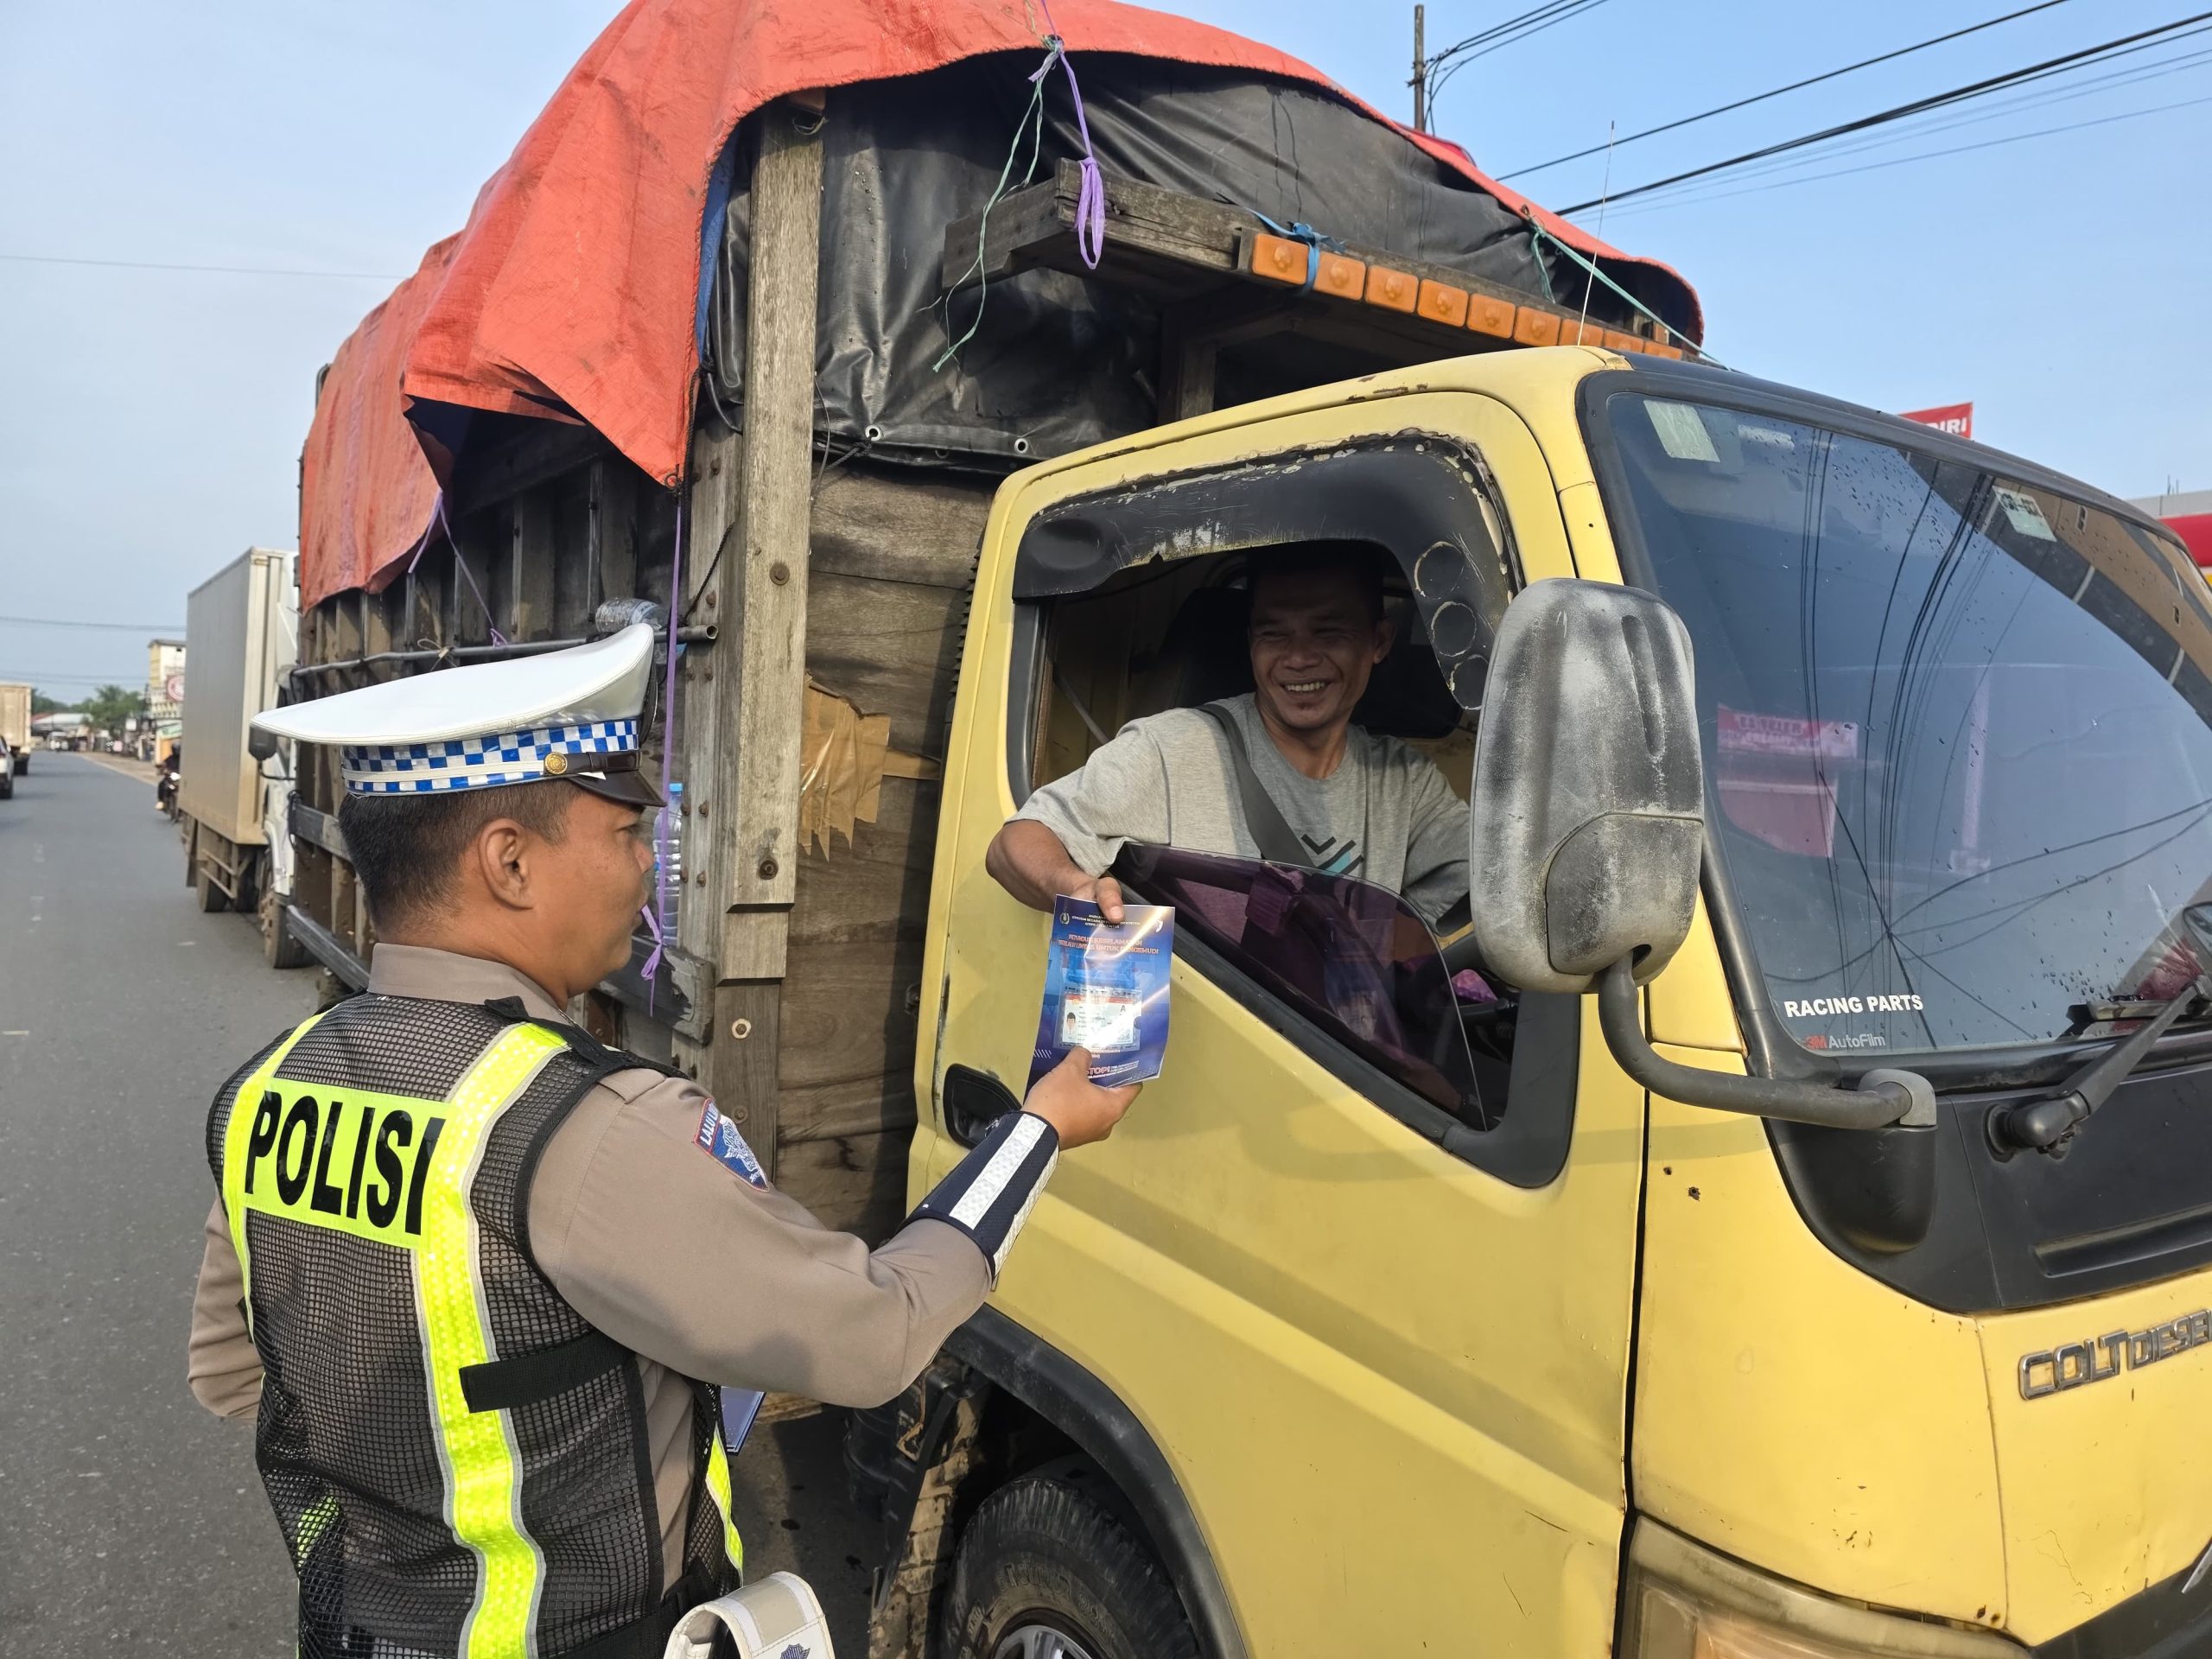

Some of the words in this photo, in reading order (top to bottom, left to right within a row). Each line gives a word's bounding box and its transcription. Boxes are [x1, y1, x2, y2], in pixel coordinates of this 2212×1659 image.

[1783, 996, 1864, 1018] RACING
[1866, 994, 1923, 1012] PARTS
[1805, 1035, 1827, 1050] 3M
[1828, 1033, 1885, 1049] AutoFilm
[245, 1090, 446, 1236] POLISI
[2018, 1329, 2128, 1401] COLT
